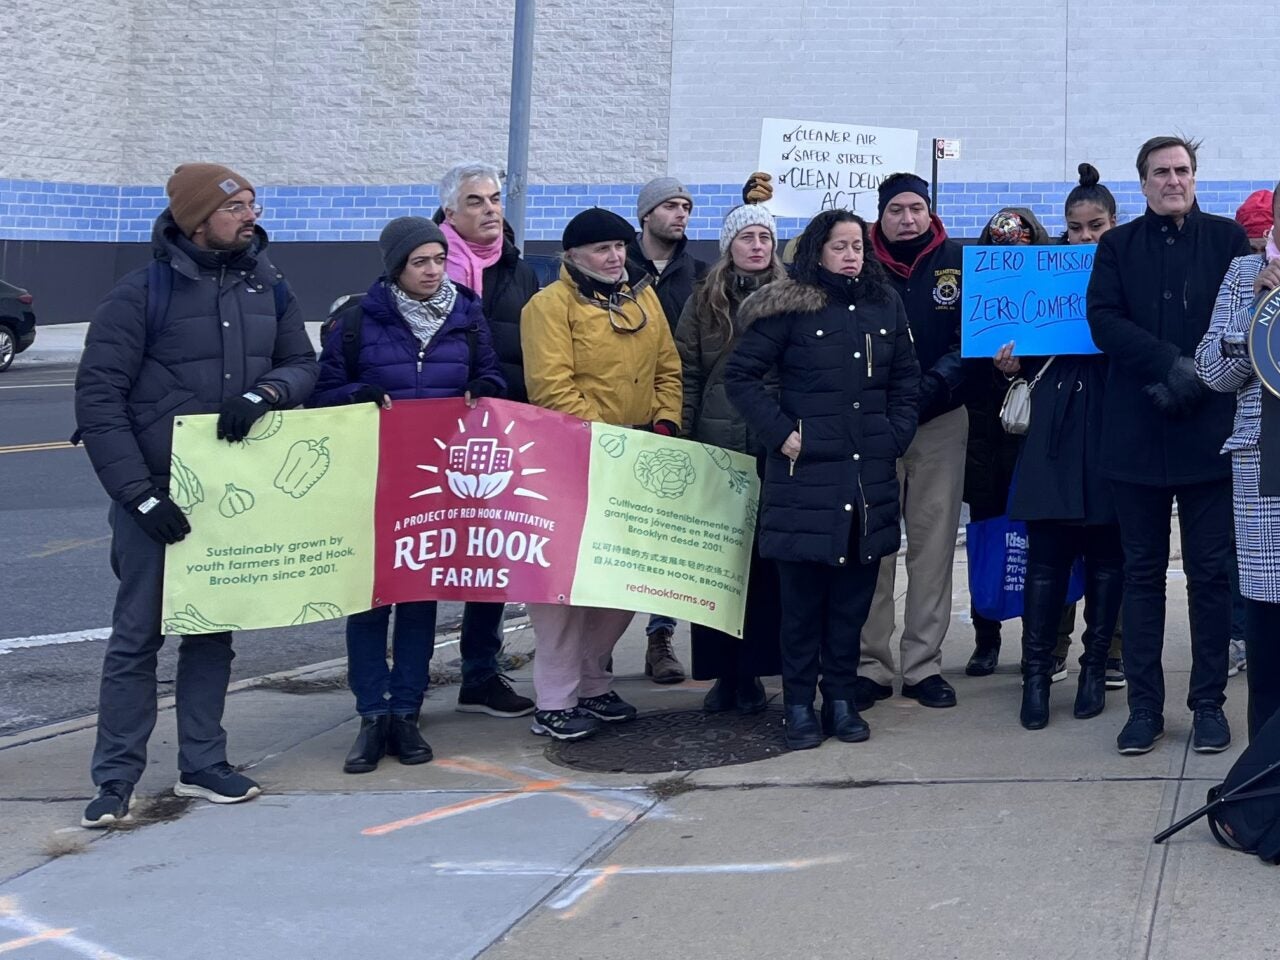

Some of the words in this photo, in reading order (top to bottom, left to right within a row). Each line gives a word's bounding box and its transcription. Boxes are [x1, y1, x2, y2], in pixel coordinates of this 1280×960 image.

[795, 129, 852, 144] CLEANER
[856, 133, 878, 146] AIR
[794, 150, 830, 163] SAFER
[836, 153, 884, 166] STREETS
[790, 167, 840, 190] CLEAN
[821, 190, 863, 212] ACT
[974, 250, 1025, 273] ZERO
[1037, 250, 1094, 272] EMISSIO
[968, 294, 1020, 323] ZERO
[393, 520, 402, 532] A
[403, 509, 446, 527] PROJECT
[447, 508, 459, 519] OF
[460, 507, 476, 519] RED
[477, 508, 503, 520] HOOK
[504, 510, 556, 531] INITIATIVE
[603, 508, 649, 525] granjeros
[650, 516, 687, 534] jóvenes
[689, 527, 702, 538] en
[703, 529, 721, 541] Red
[608, 496, 654, 514] Cultivado
[656, 507, 730, 531] sosteniblemente
[205, 542, 285, 558] Sustainably
[287, 538, 326, 553] grown
[329, 535, 344, 548] by
[628, 524, 669, 542] Brooklyn
[670, 534, 700, 548] desde
[393, 527, 457, 571] RED
[466, 526, 551, 568] HOOK
[186, 561, 226, 575] youth
[228, 557, 280, 572] farmers
[283, 555, 295, 566] in
[299, 551, 323, 564] Red
[208, 572, 269, 586] Brooklyn
[272, 569, 306, 582] since
[430, 567, 510, 588] FARMS
[626, 581, 717, 611] redhookfarms.org
